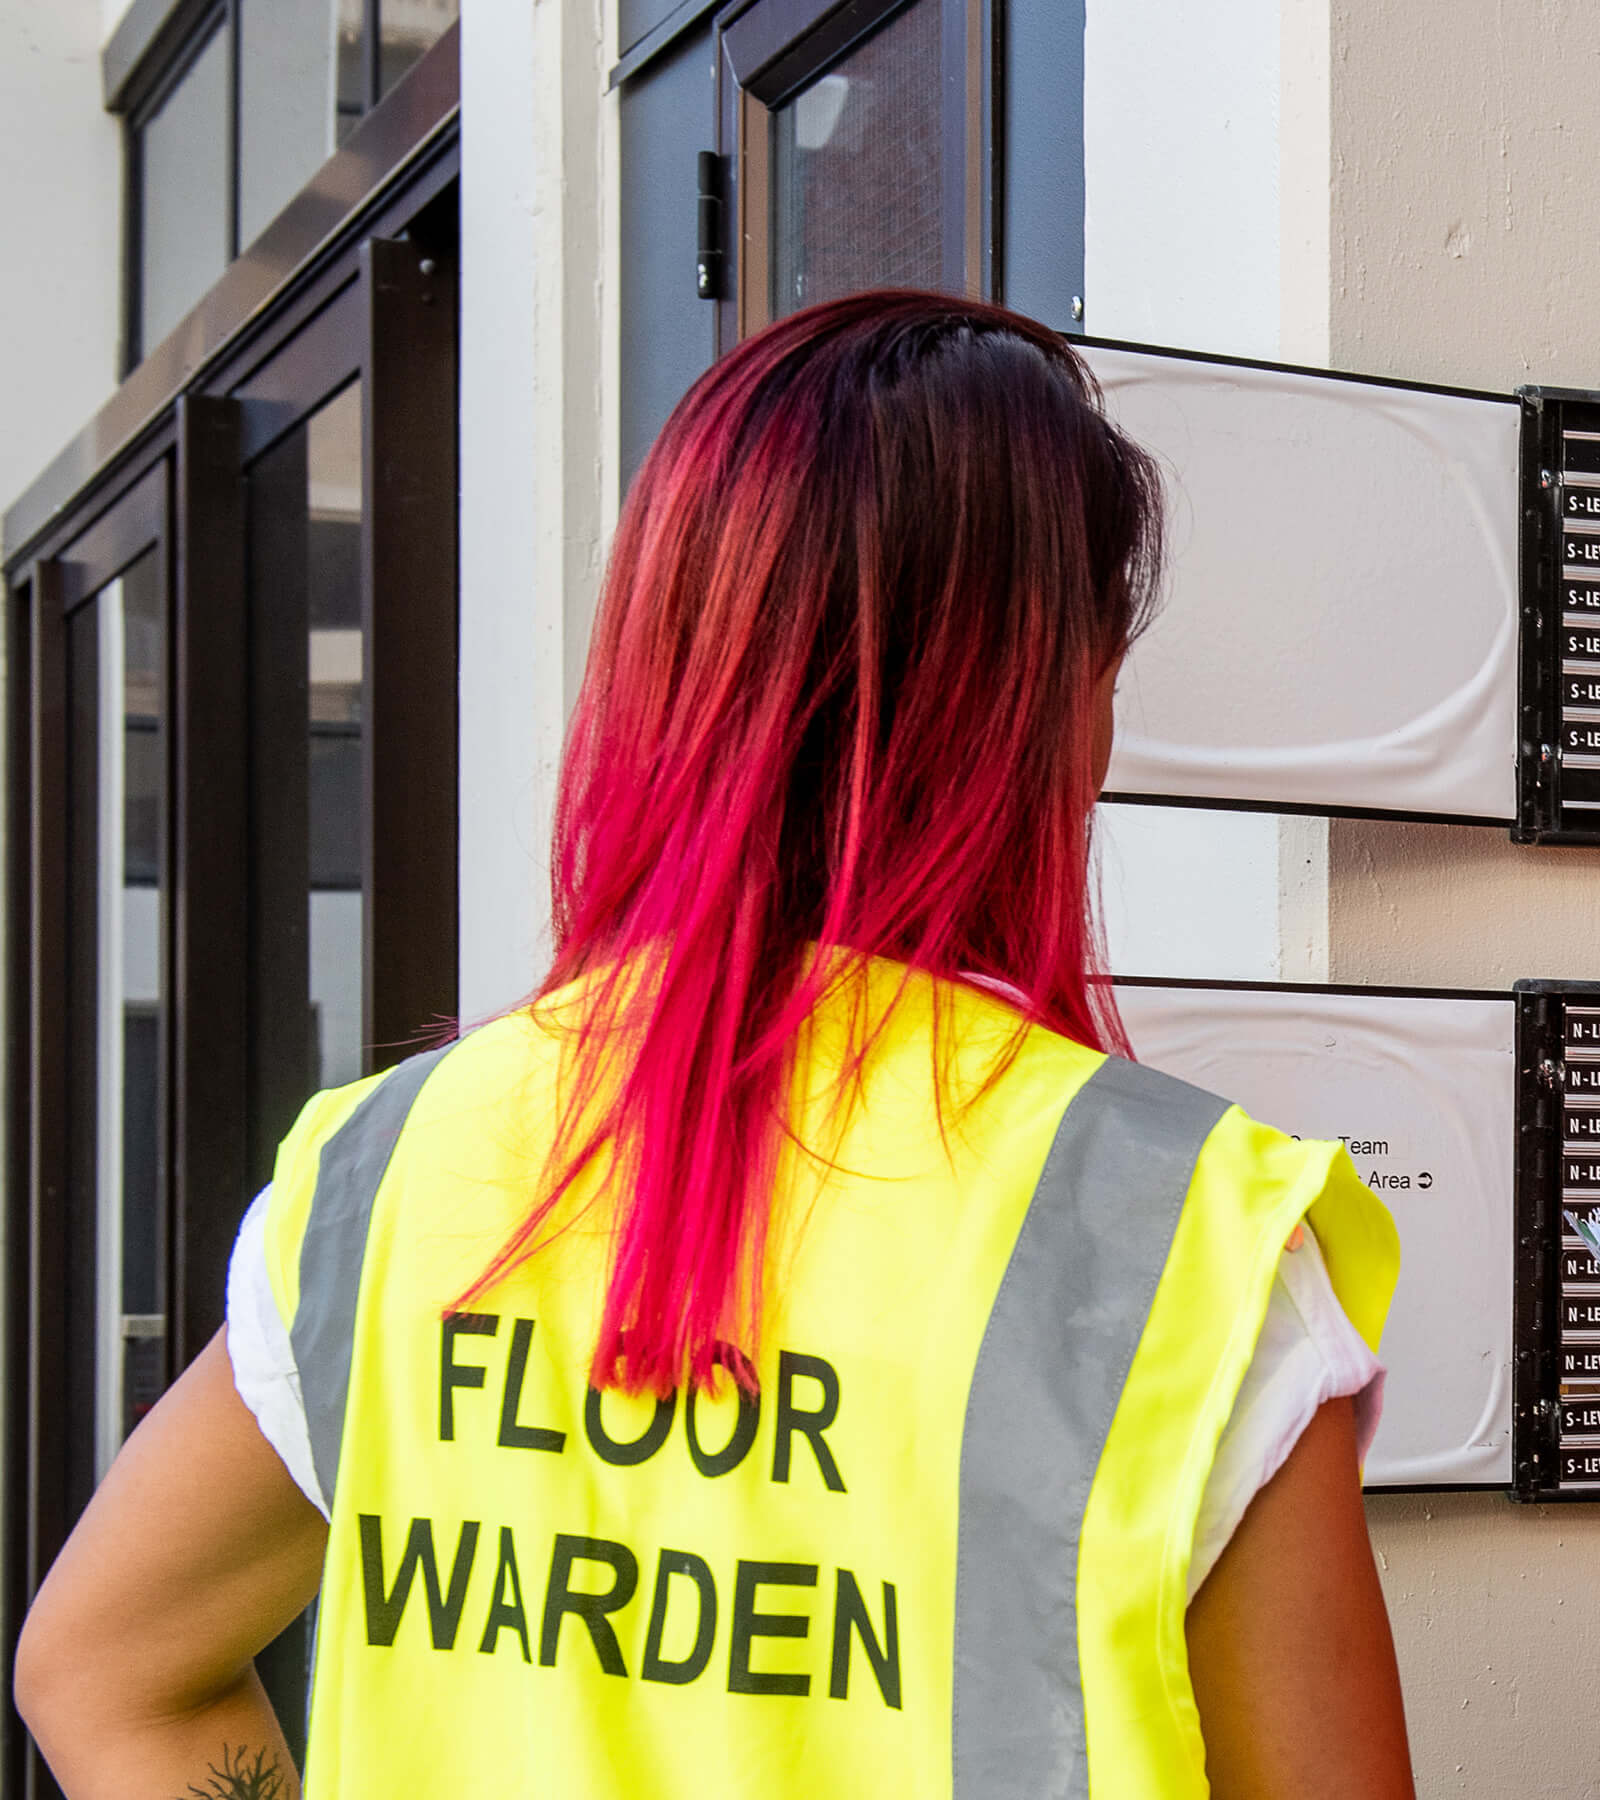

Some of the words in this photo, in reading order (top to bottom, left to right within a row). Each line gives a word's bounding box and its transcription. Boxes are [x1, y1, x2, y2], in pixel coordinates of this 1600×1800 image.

[1569, 495, 1578, 511] S
[1567, 542, 1576, 559] S
[1568, 589, 1577, 605] S
[1568, 636, 1578, 652] S
[1570, 683, 1580, 699] S
[1569, 730, 1578, 746] S
[1573, 1022, 1583, 1039] N
[1571, 1070, 1581, 1087] N
[1569, 1118, 1580, 1134] N
[1367, 1170, 1411, 1189] Area
[1569, 1164, 1580, 1181] N
[1567, 1259, 1577, 1275] N
[1568, 1307, 1578, 1322] N
[1565, 1355, 1575, 1370] N
[438, 1309, 848, 1493] FLOOR
[1566, 1411, 1574, 1427] S
[1567, 1458, 1576, 1474] S
[358, 1513, 903, 1712] WARDEN
